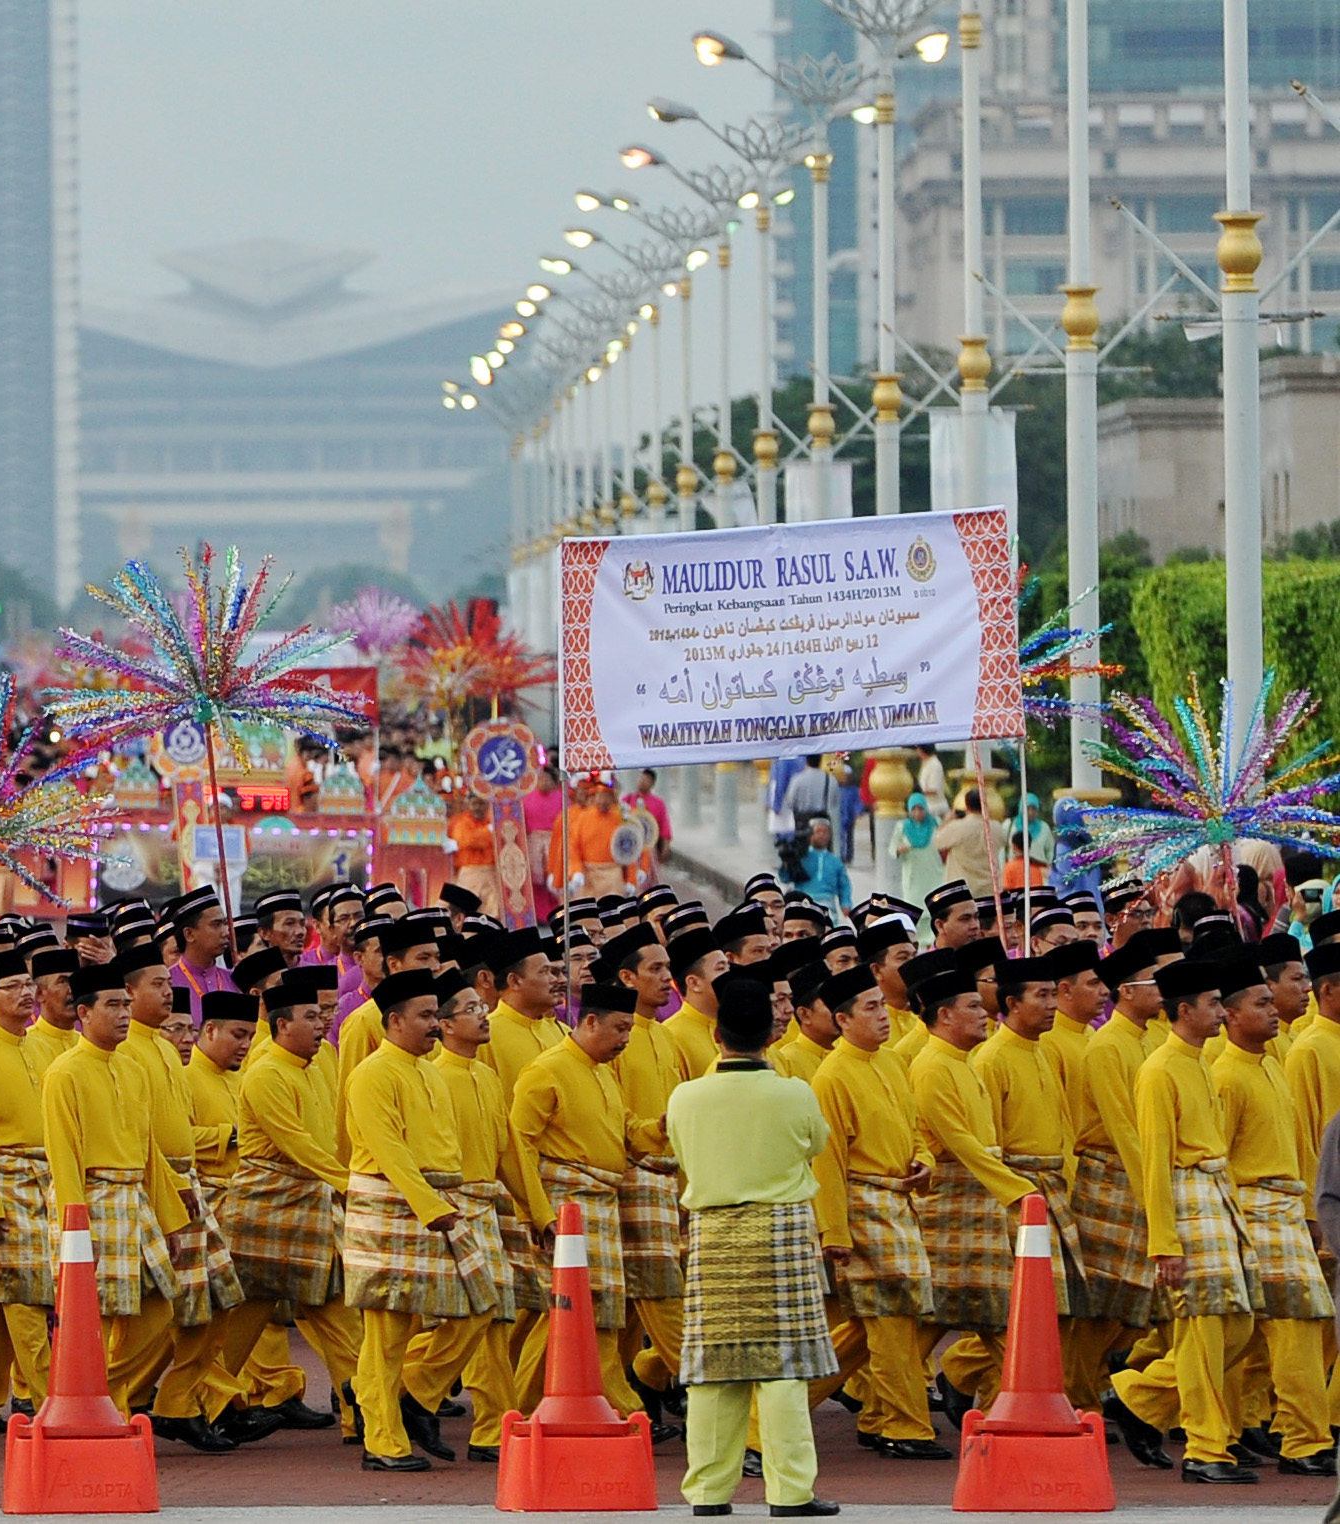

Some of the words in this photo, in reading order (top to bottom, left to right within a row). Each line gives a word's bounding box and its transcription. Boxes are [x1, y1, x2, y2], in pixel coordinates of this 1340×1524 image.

[662, 559, 766, 594] MAULIDUR
[776, 553, 836, 587] RASUL
[844, 548, 899, 582] S.A.W.
[664, 601, 713, 616] Peringkat
[718, 598, 786, 613] Kebangsaan
[789, 594, 823, 606] Tahun
[827, 585, 902, 603] 1434H/2013M
[638, 719, 732, 749] WASATIYYAH
[735, 713, 806, 743] TONGGAK
[807, 706, 879, 738] KESATUAN
[879, 701, 939, 729] UMMAH
